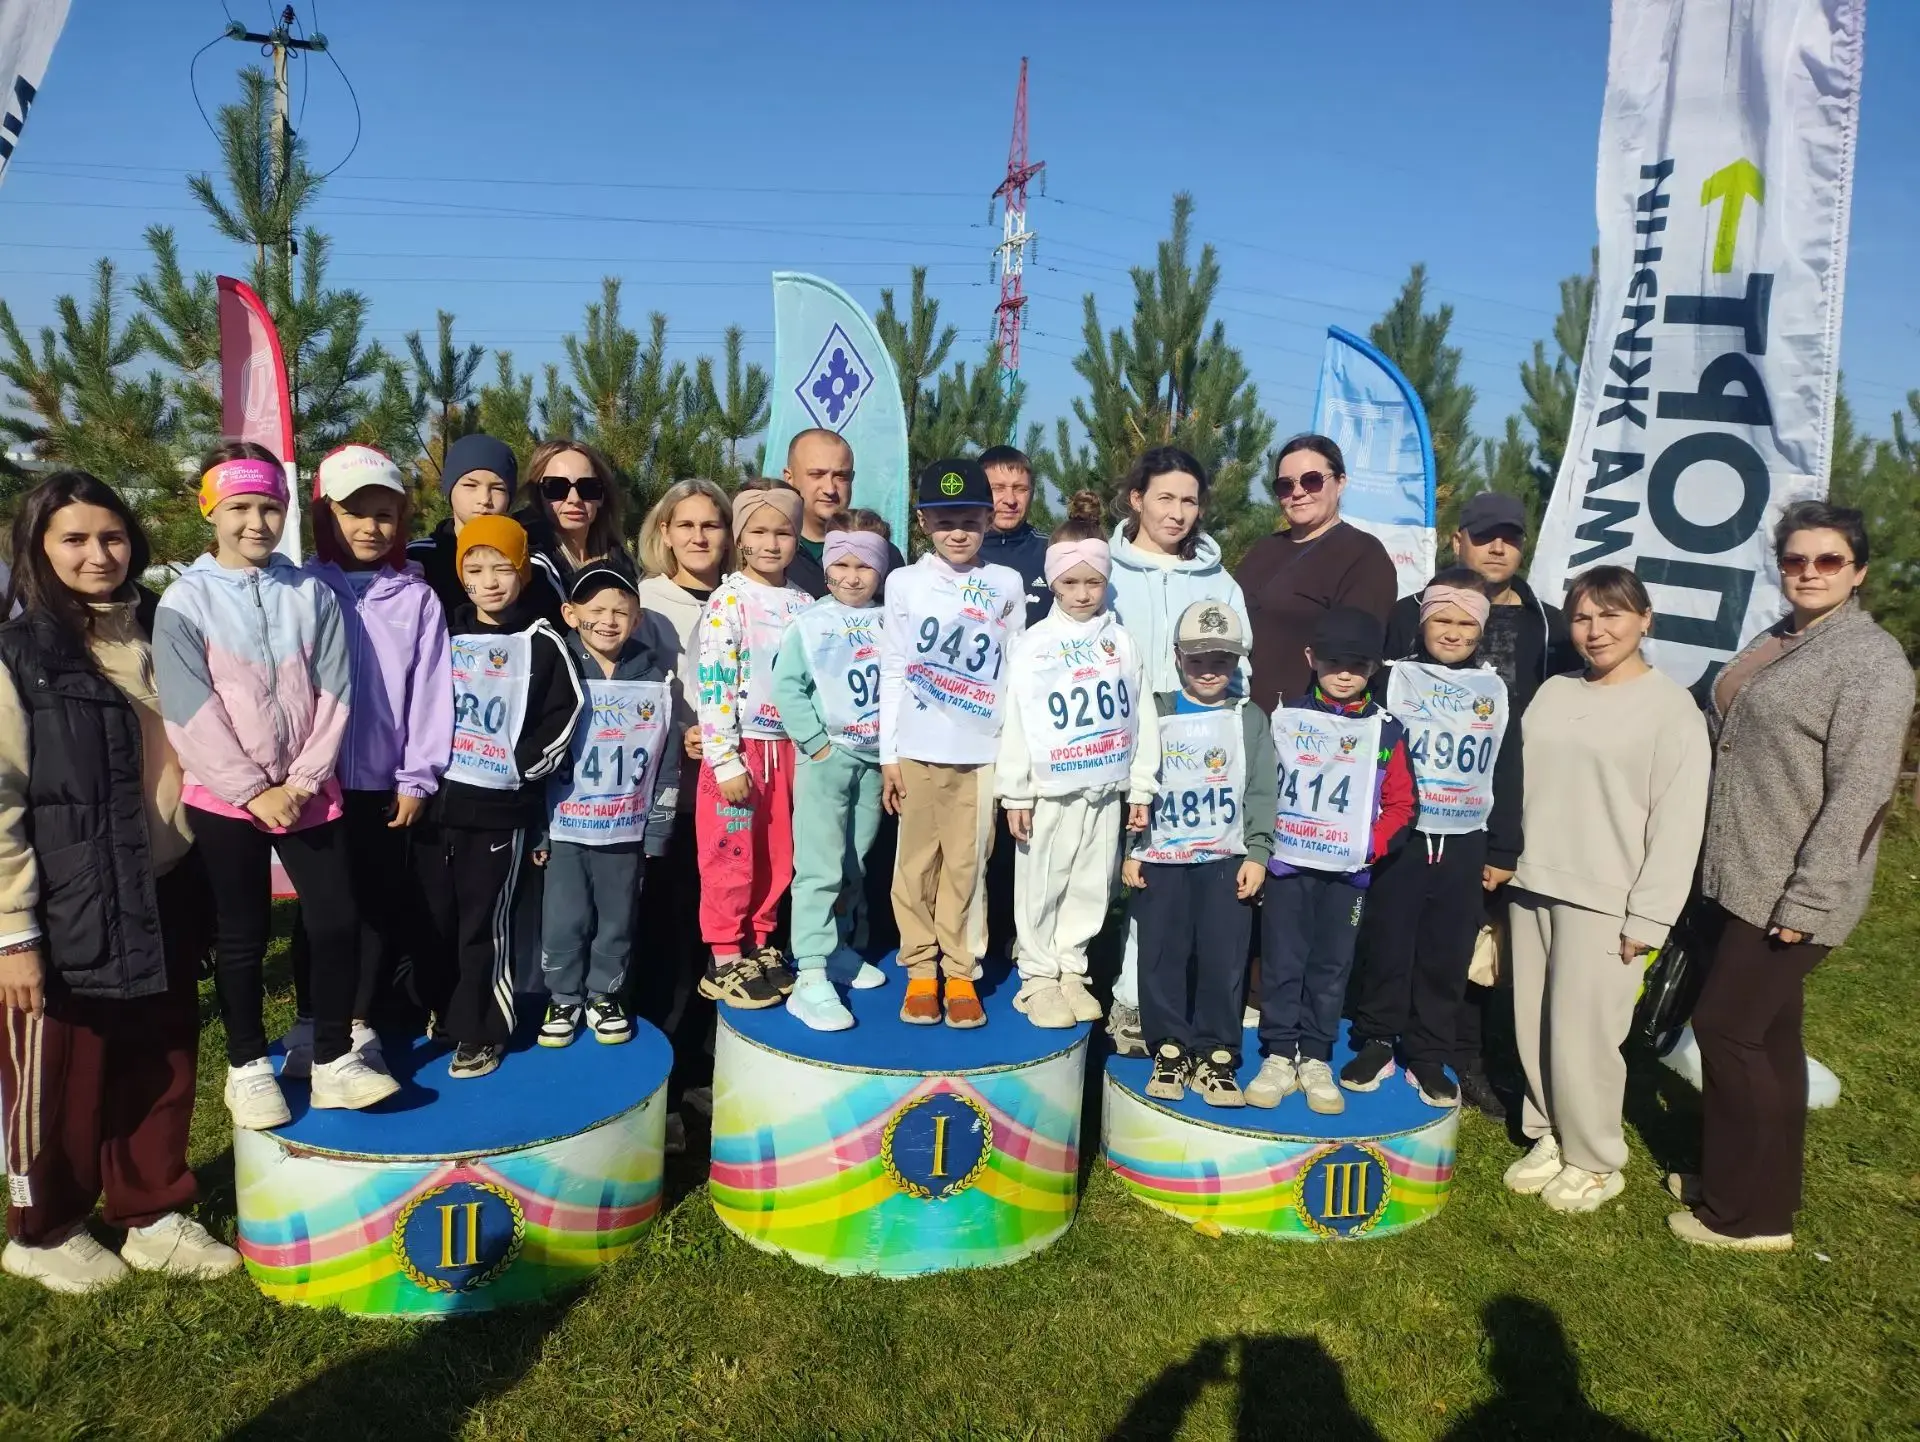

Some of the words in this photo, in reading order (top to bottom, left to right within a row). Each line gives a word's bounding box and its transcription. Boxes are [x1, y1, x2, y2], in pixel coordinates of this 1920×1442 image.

[916, 616, 1003, 681] 9431
[847, 663, 880, 707] 92
[907, 664, 935, 681] КРОСС
[935, 675, 969, 696] НАЦИИ
[973, 688, 996, 705] 2013
[911, 673, 947, 702] СПУБЛИКА
[947, 695, 993, 719] ТАТАРСТАН
[1048, 678, 1131, 730] 9269
[481, 743, 507, 760] 2013
[1050, 745, 1083, 761] КРОСС
[1084, 739, 1115, 757] НАЦИИ
[456, 752, 509, 776] ТАТАРСТАН
[1050, 758, 1104, 773] РЕСПУБЛИКА
[559, 800, 591, 817] КРОСС
[593, 800, 627, 818] НАЦИИ
[1424, 791, 1458, 805] НАЦИИ
[559, 814, 611, 830] РЕСПУБЛИКА
[1441, 807, 1481, 818] ТАТАРСТАН
[1285, 821, 1317, 838] НАЦИИ
[1325, 829, 1349, 843] 2013
[1146, 849, 1173, 860] КРОСС
[1301, 838, 1350, 857] ТАТАРСТАН
[931, 1115, 950, 1177] I
[1320, 1161, 1371, 1218] III
[435, 1202, 484, 1269] II
